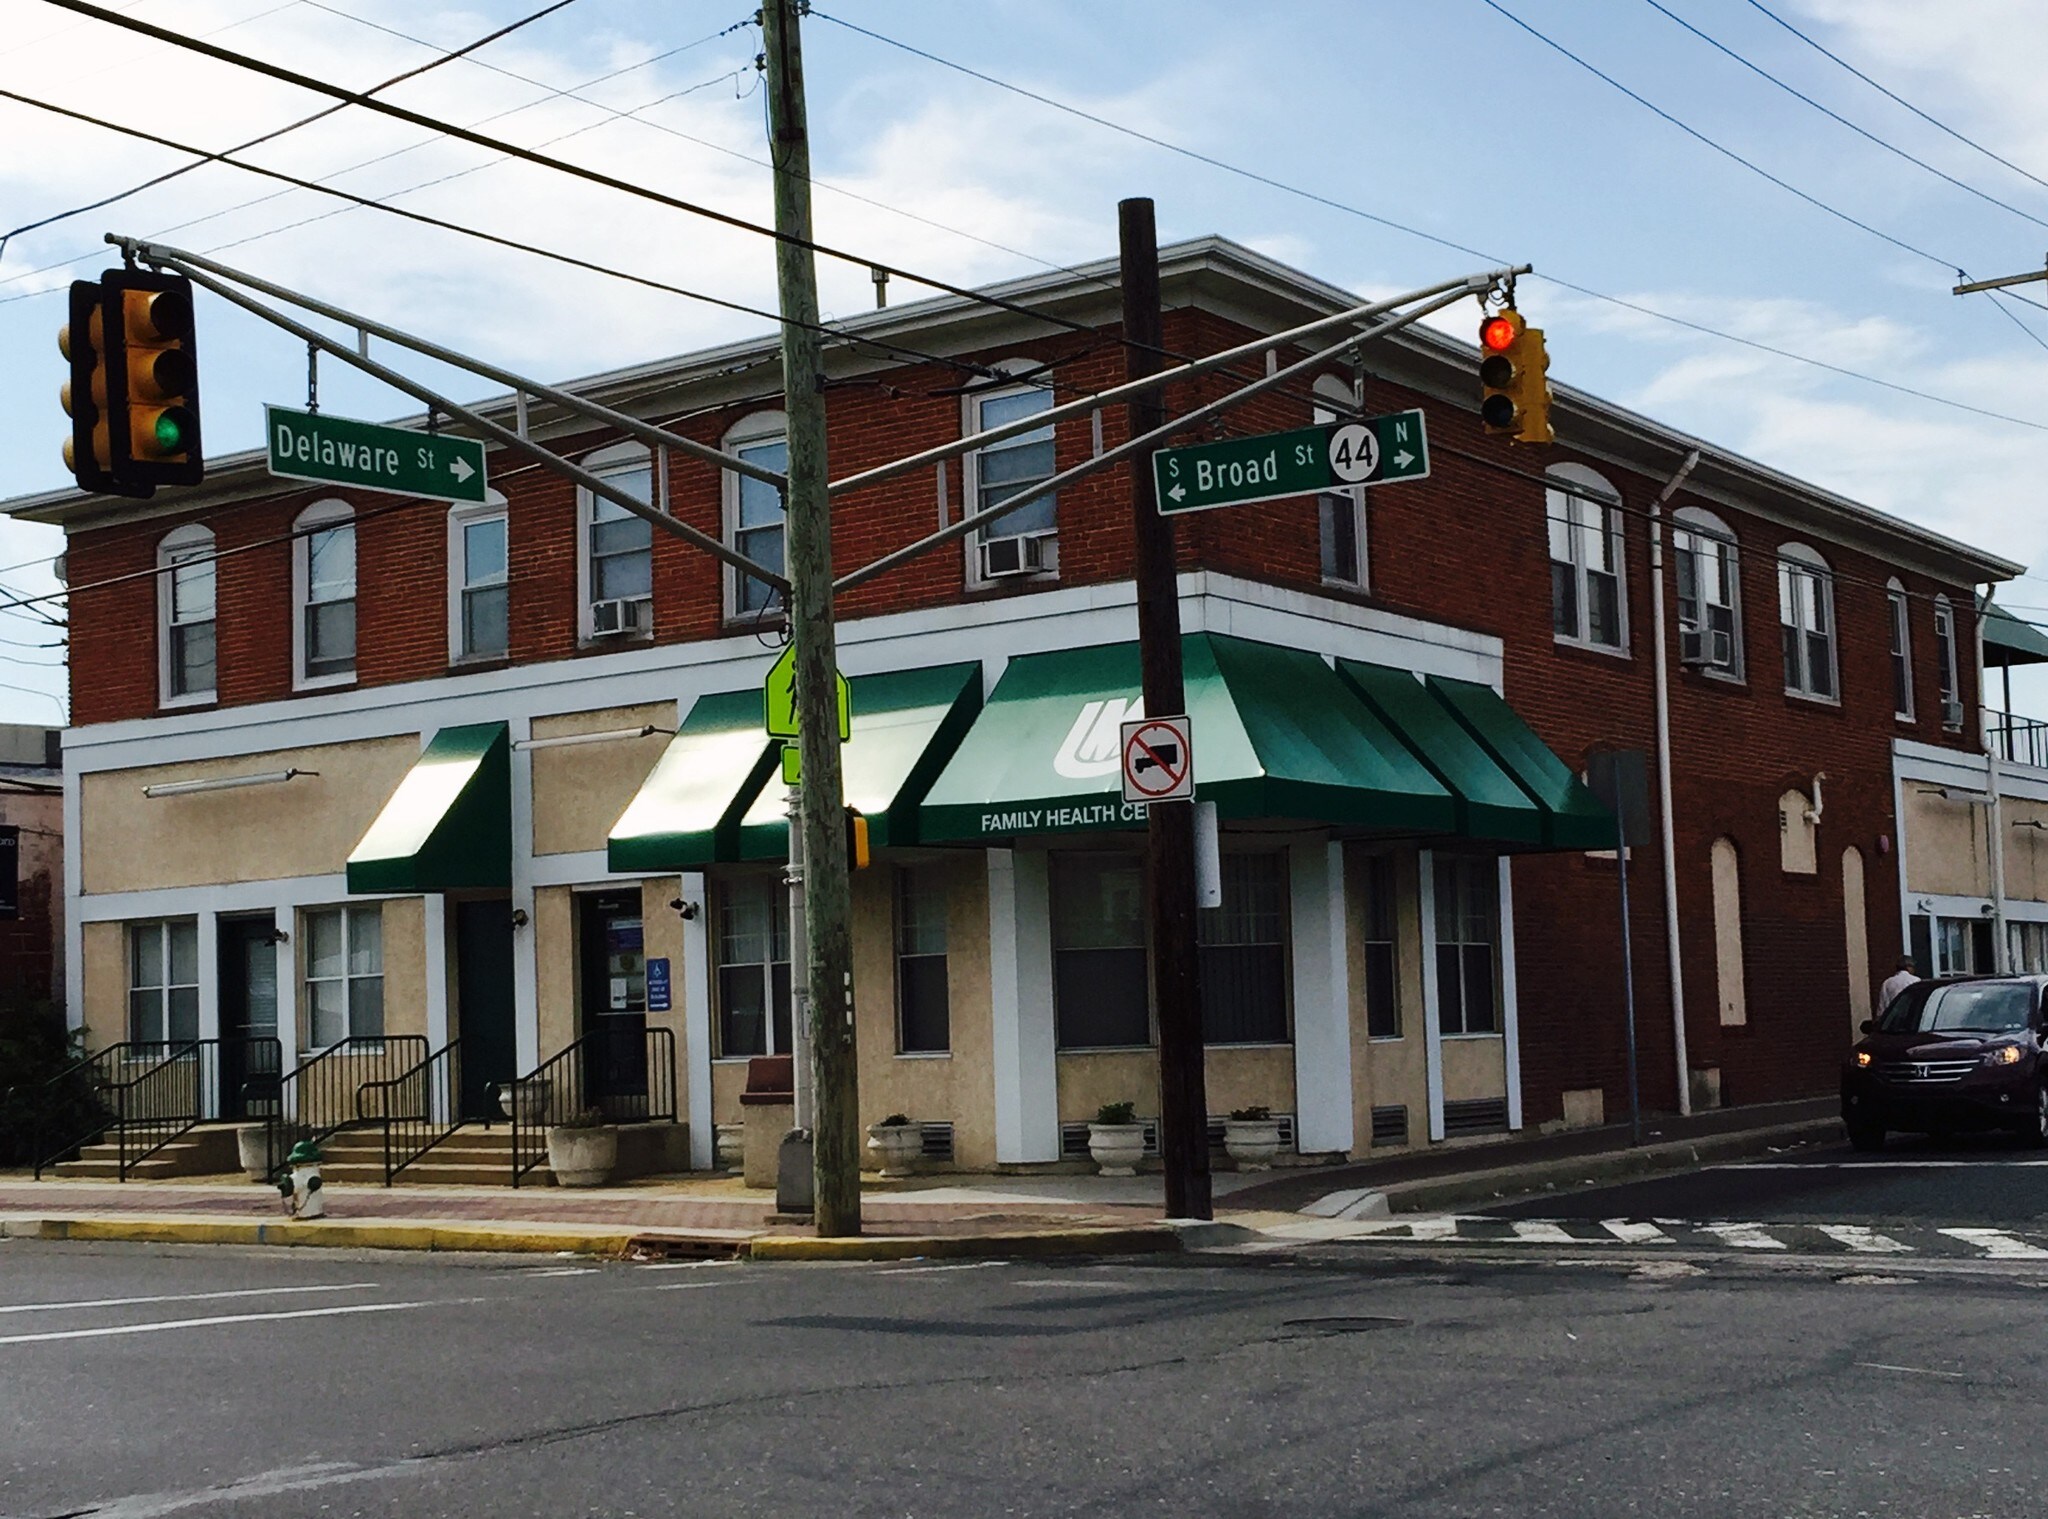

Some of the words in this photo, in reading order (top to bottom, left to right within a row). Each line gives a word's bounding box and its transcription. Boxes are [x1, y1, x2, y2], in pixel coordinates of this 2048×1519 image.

[277, 424, 399, 475] Delaware
[417, 448, 435, 470] St
[1169, 457, 1180, 478] S
[1196, 450, 1278, 492] Broad
[1295, 444, 1314, 466] St
[1334, 435, 1374, 470] 44
[1395, 421, 1409, 443] N
[981, 809, 1042, 832] FAMILY
[1046, 804, 1115, 827] HEALTH
